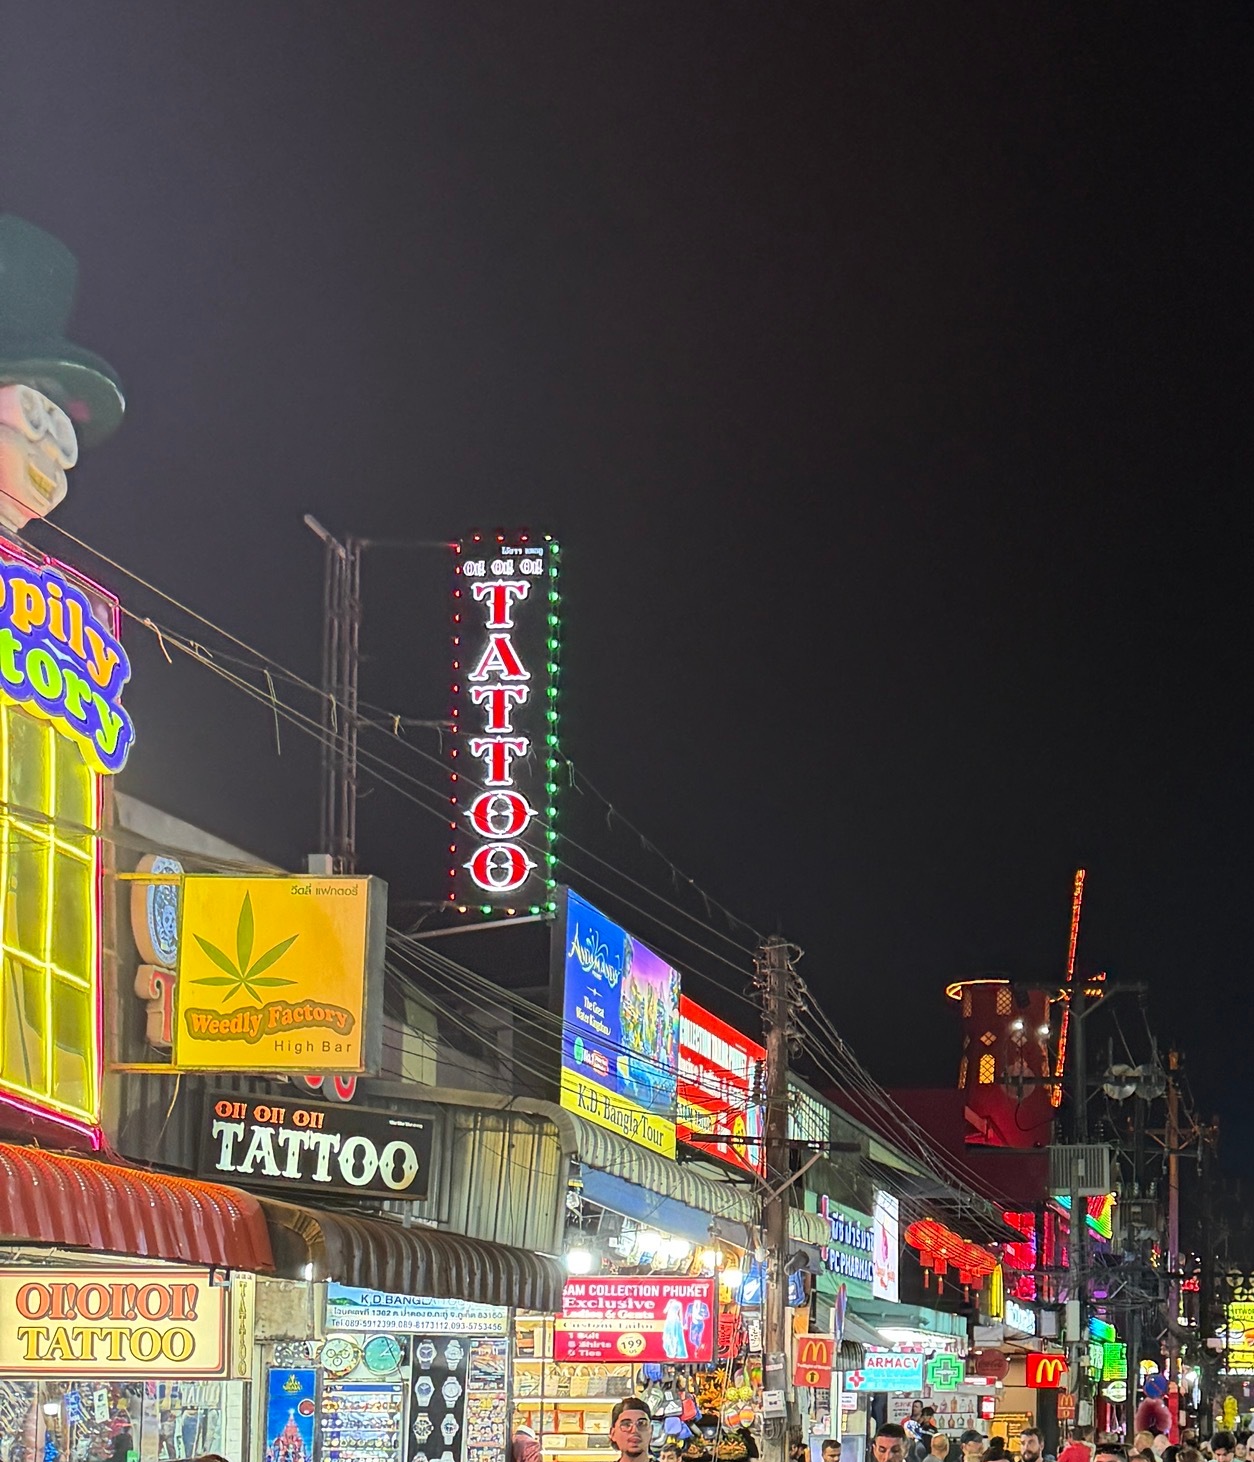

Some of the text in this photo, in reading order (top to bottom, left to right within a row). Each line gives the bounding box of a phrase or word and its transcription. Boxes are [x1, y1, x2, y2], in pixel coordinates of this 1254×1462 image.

[0, 574, 120, 687] pily
[463, 579, 538, 892] TATTOO
[190, 1004, 349, 1038] Weedly Factory
[274, 1040, 352, 1055] High Bar
[215, 1101, 325, 1129] OI! OI! OI!
[603, 1096, 639, 1135] Bangla
[641, 1115, 664, 1147] Tour
[212, 1119, 419, 1190] TATTOO
[563, 1297, 656, 1309] Exclusive
[588, 1284, 660, 1297] COLLECTION
[663, 1284, 709, 1298] PHUKET
[17, 1327, 195, 1362] TATTOO
[621, 1339, 642, 1350] 199
